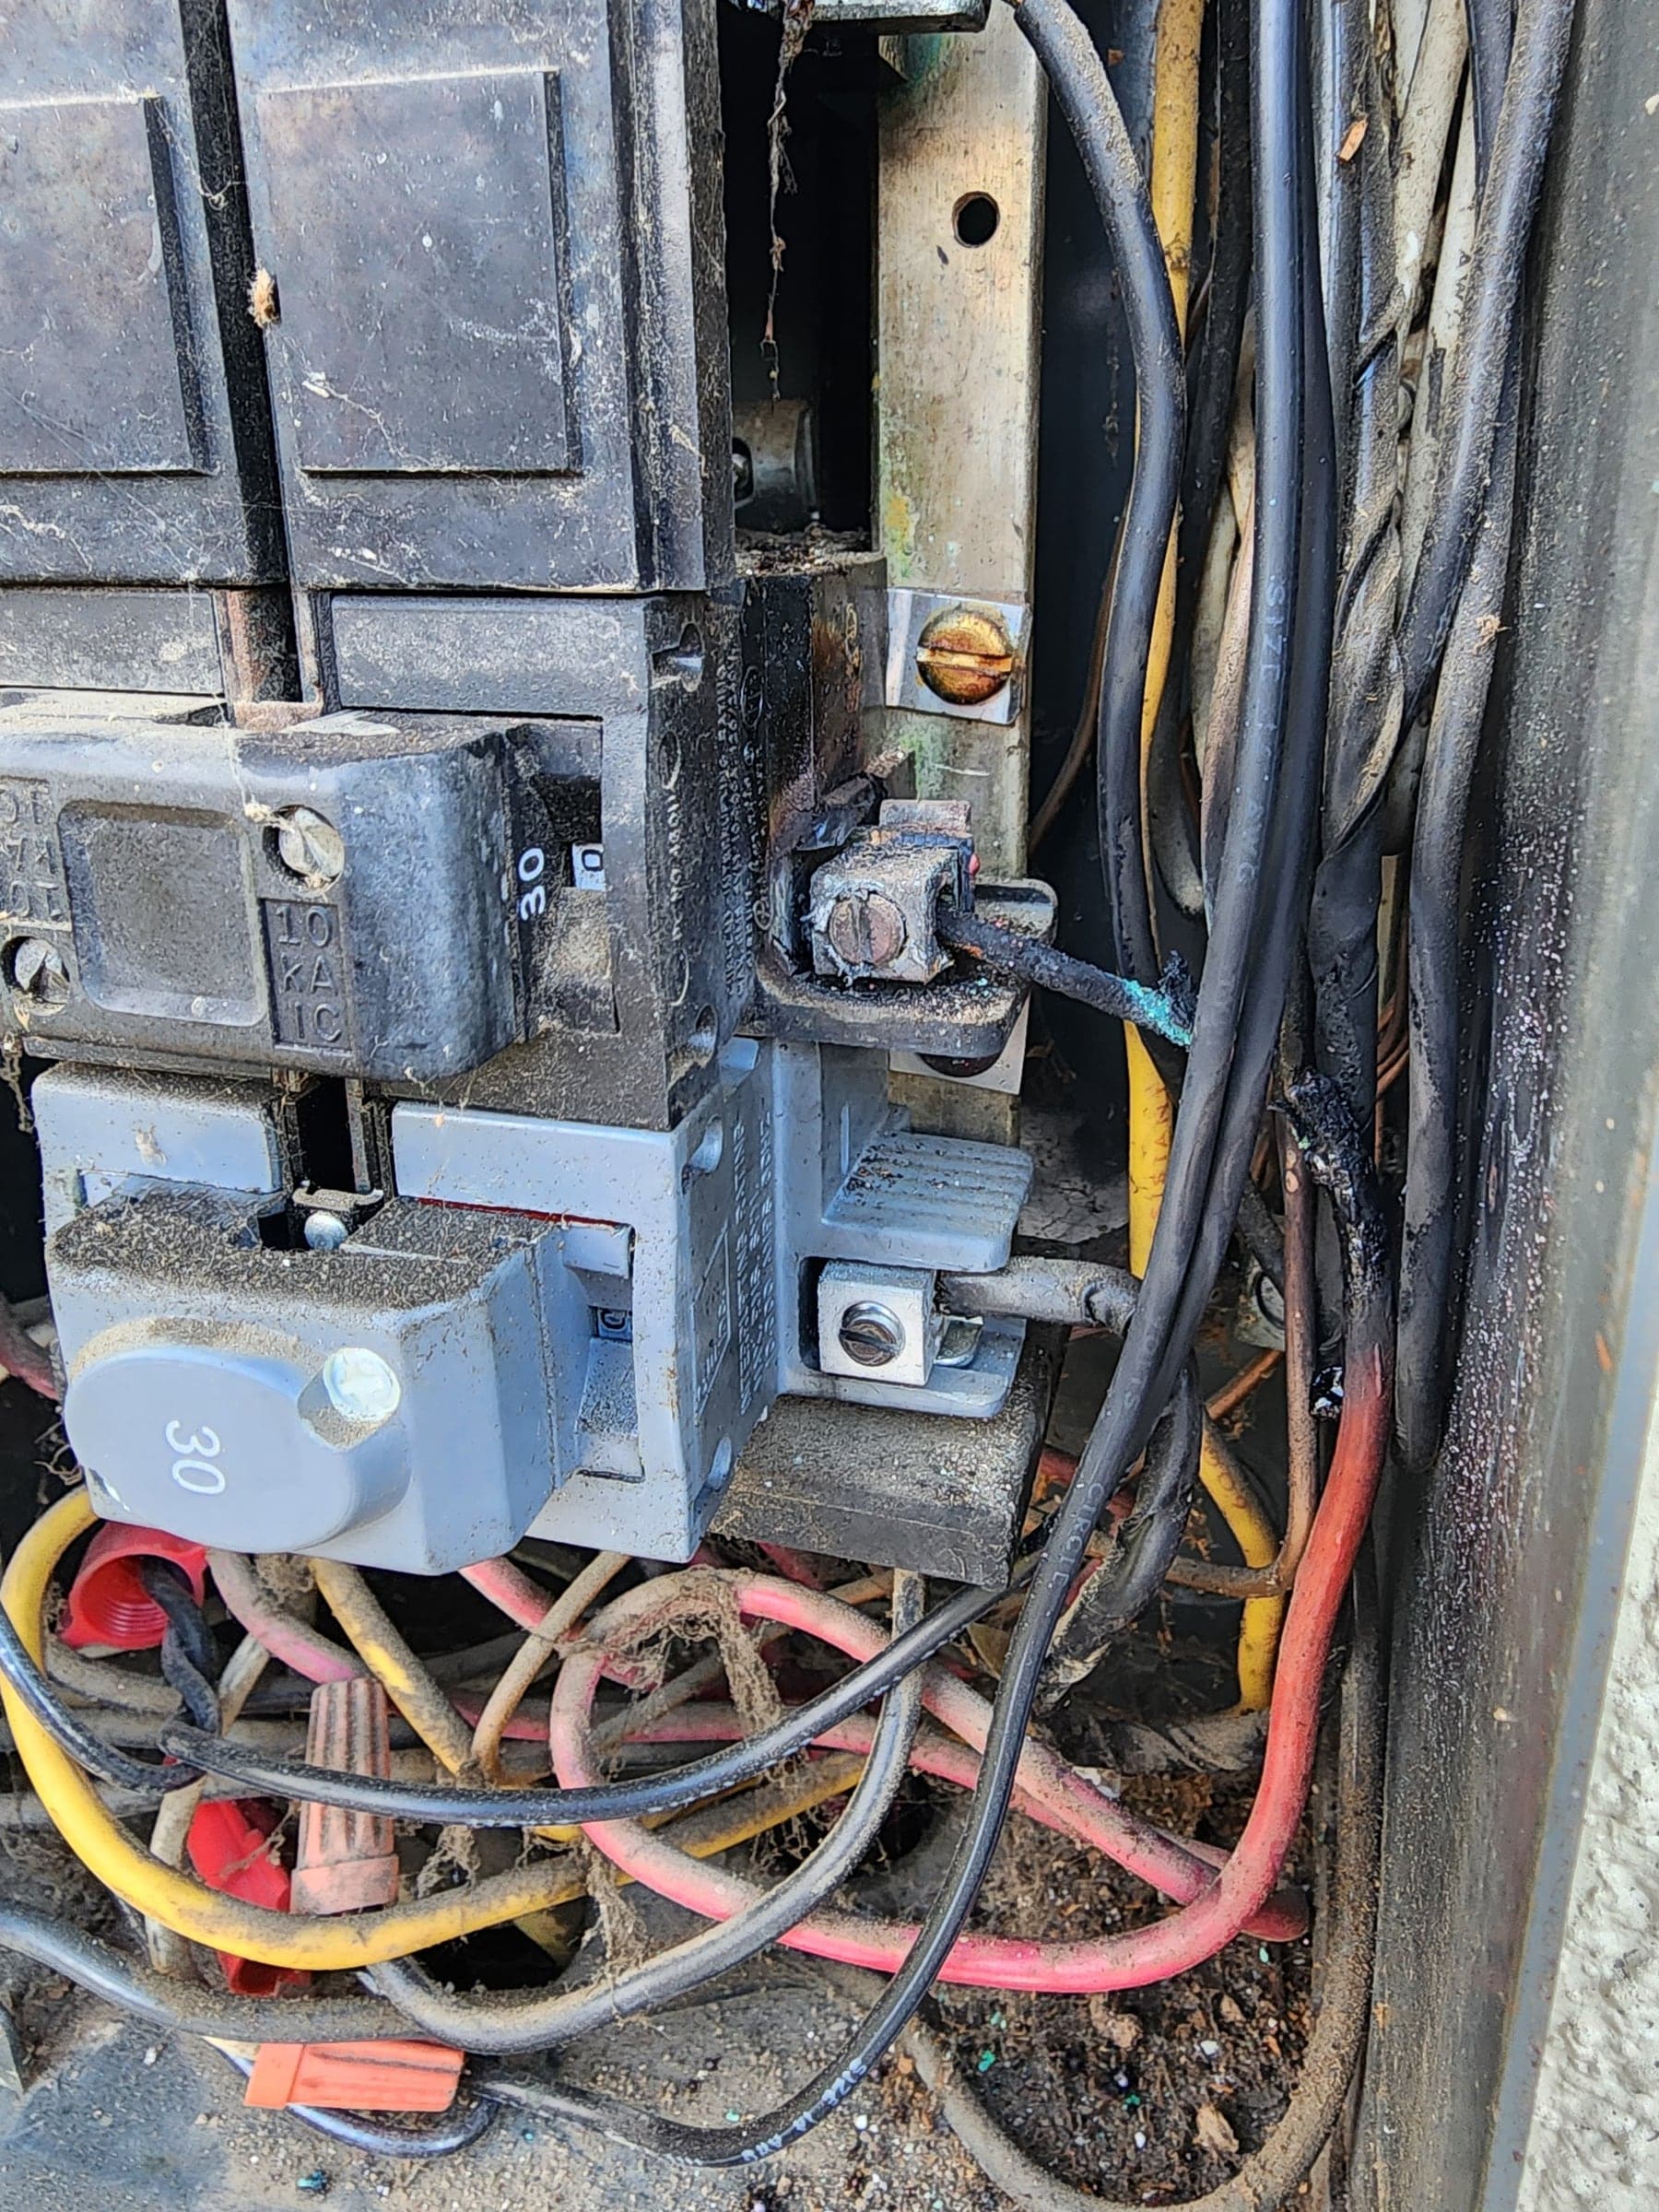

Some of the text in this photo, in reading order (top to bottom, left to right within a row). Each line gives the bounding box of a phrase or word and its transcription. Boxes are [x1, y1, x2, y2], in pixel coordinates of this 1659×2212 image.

[1263, 581, 1286, 682] SIZE
[518, 847, 546, 922] 30
[276, 904, 334, 947] 10
[280, 954, 339, 999] KA
[294, 1003, 343, 1044] IC
[733, 1120, 752, 1416] INTERRUPTING RATING
[164, 1418, 226, 1496] 30
[821, 2056, 868, 2107] SIZE
